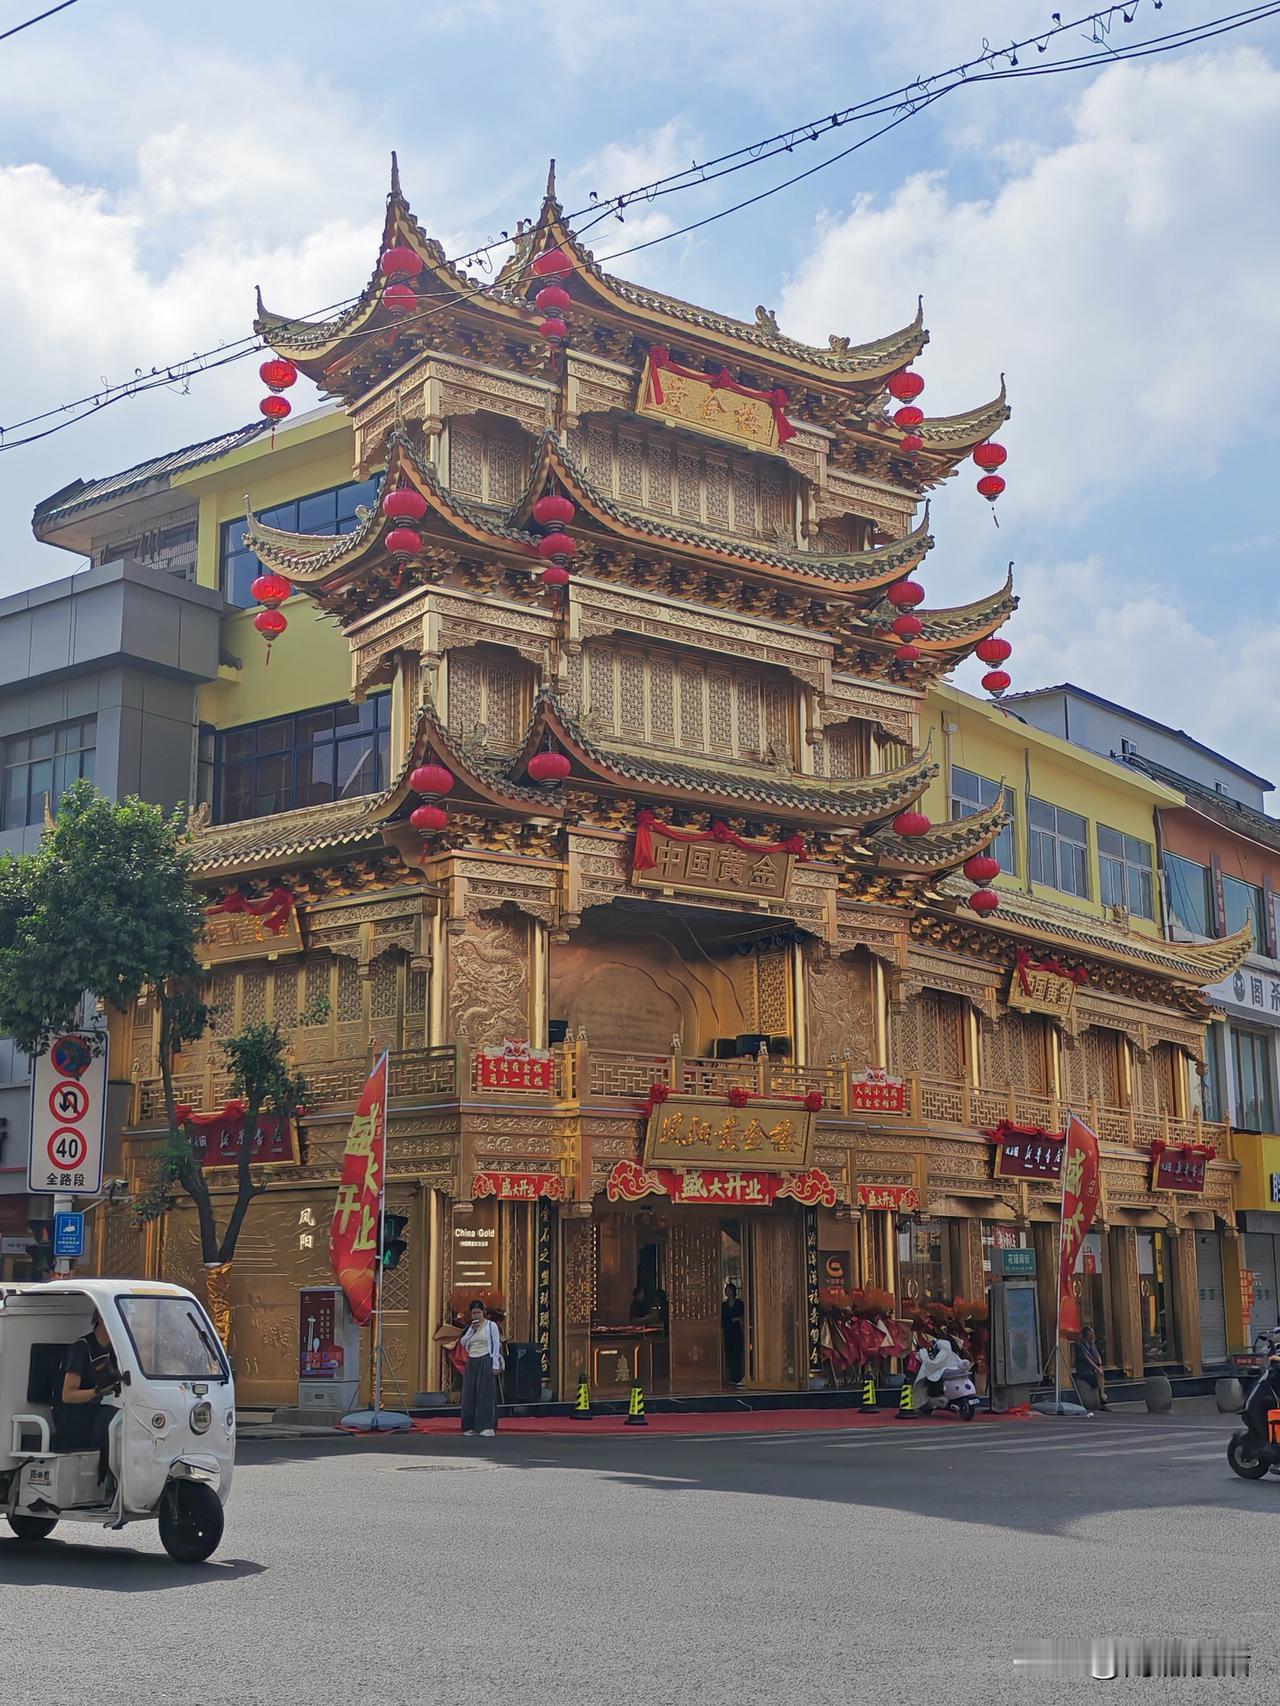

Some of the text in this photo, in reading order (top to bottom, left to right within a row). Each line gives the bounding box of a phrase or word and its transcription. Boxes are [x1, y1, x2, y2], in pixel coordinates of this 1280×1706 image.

[656, 840, 779, 889] 中国黄金
[56, 1138, 78, 1159] 40
[46, 1172, 85, 1187] 全路段
[501, 1177, 536, 1198] 盛大开业
[681, 1172, 764, 1201] 盛大开业
[297, 1207, 317, 1251] 凤阳
[455, 1228, 495, 1238] China Gold
